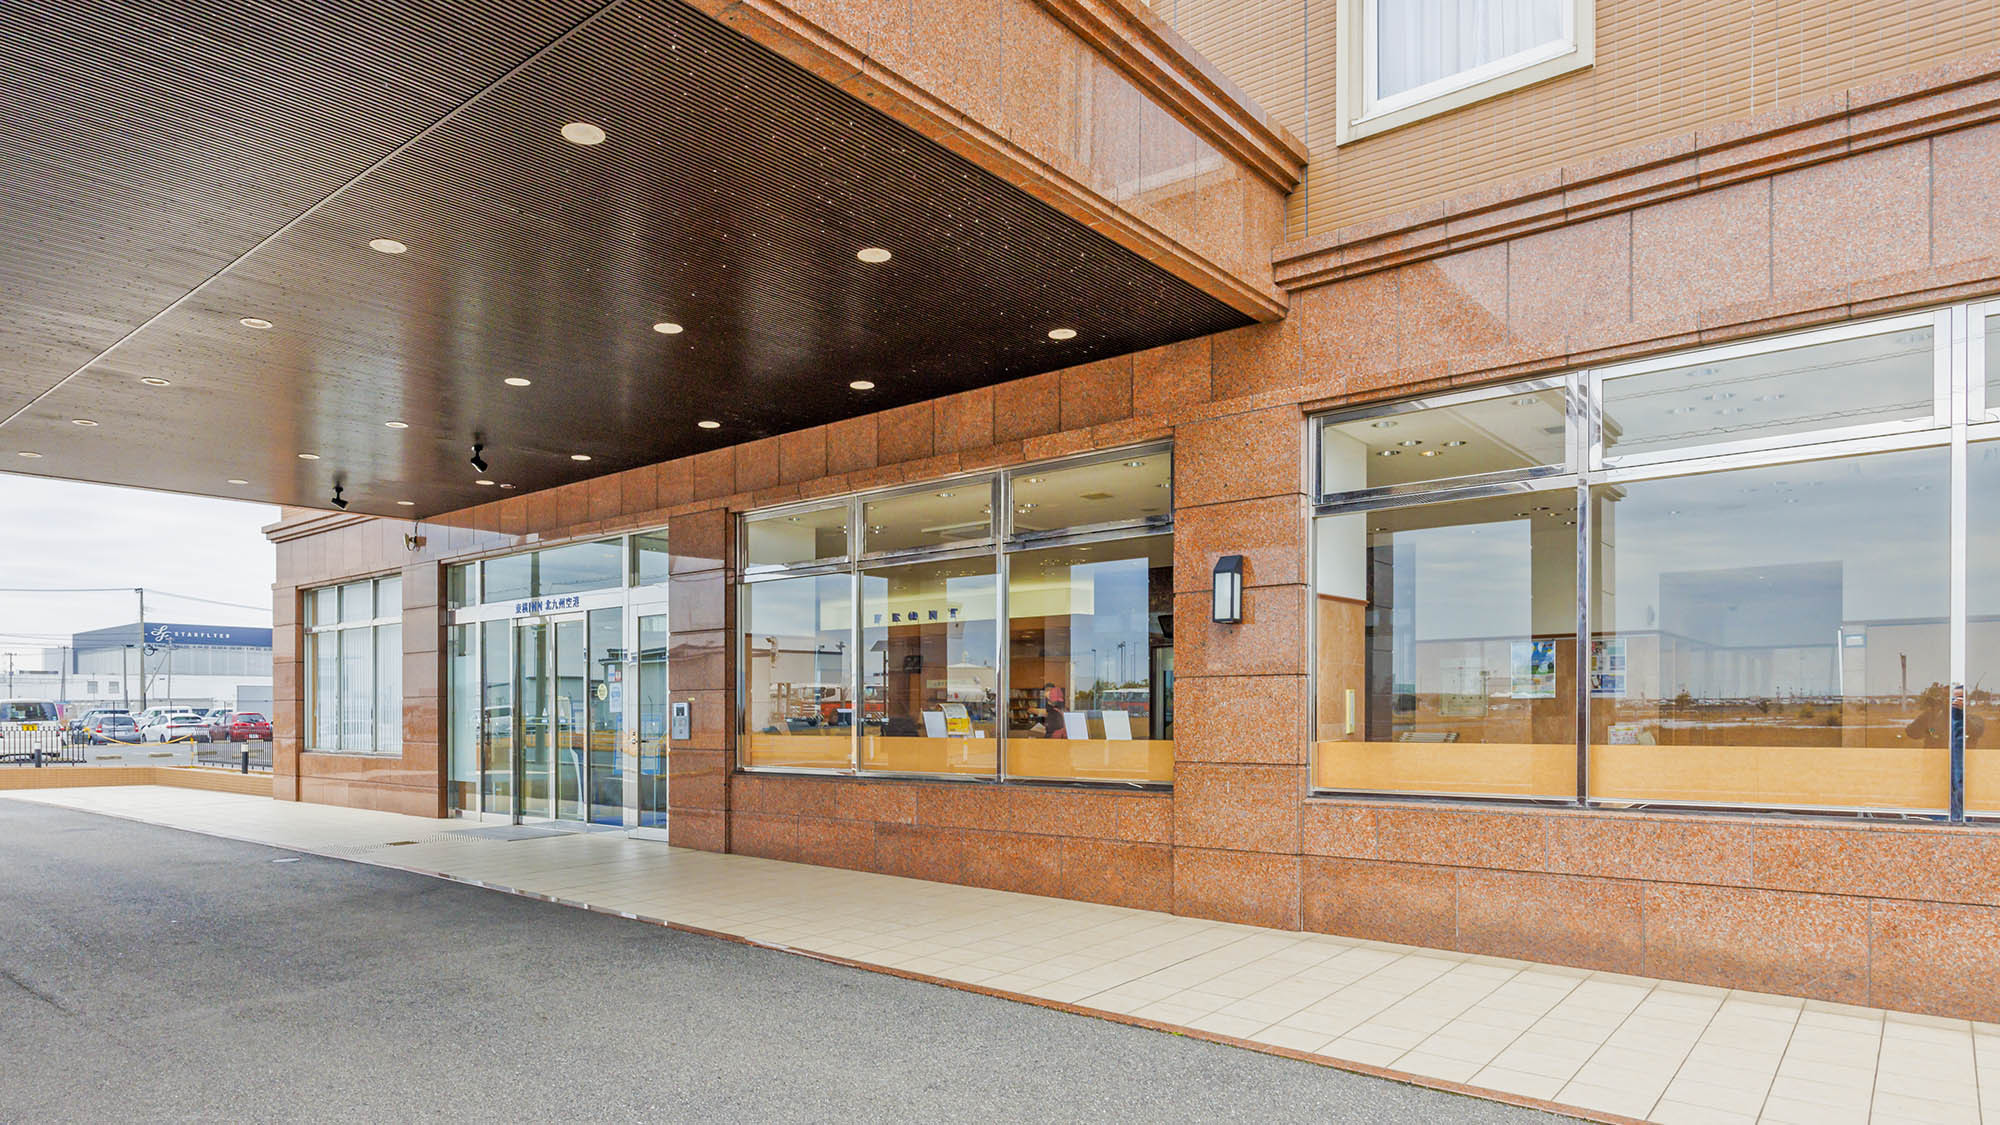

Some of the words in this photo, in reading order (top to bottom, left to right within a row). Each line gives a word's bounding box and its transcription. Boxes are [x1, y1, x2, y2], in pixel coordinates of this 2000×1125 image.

[545, 596, 580, 610] 北九州空港
[174, 631, 231, 639] STARFLYER
